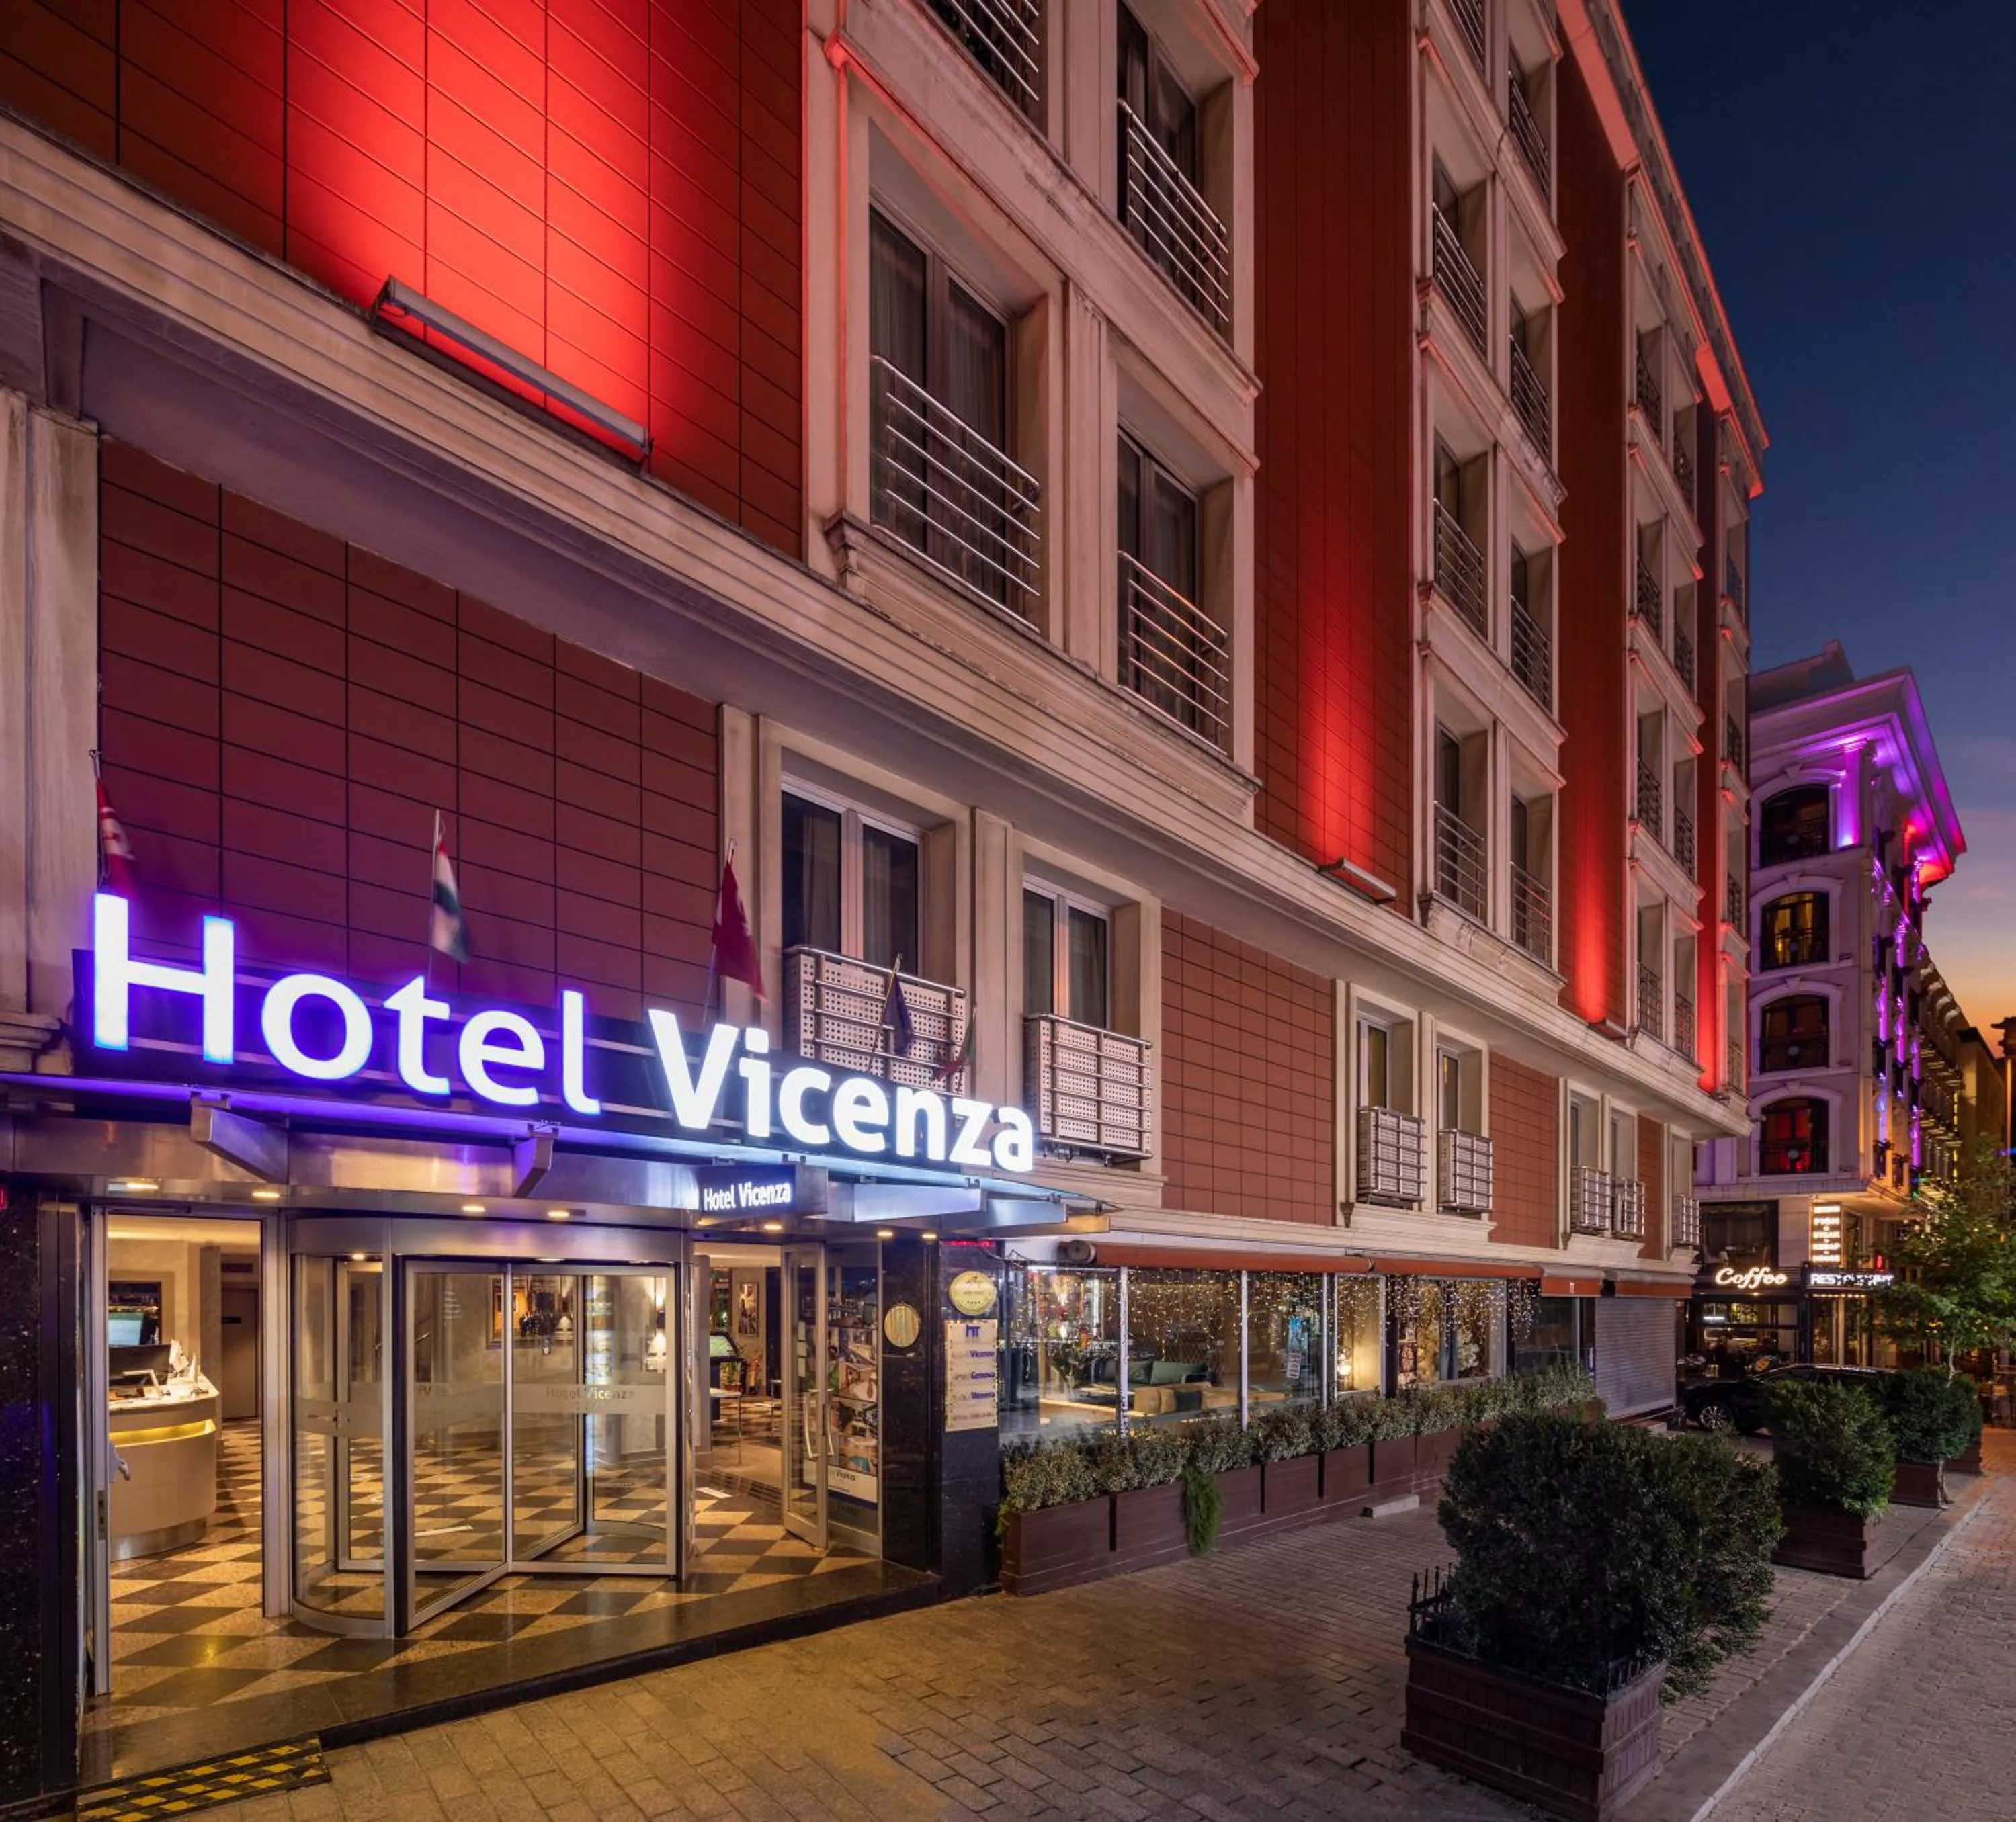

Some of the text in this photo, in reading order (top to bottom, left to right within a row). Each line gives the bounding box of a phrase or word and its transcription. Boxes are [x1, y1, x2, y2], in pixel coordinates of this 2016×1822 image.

[94, 893, 1034, 1172] Hotel Vicenza
[704, 1182, 792, 1211] Hotel Vicenza
[1715, 1267, 1788, 1289] Coffee
